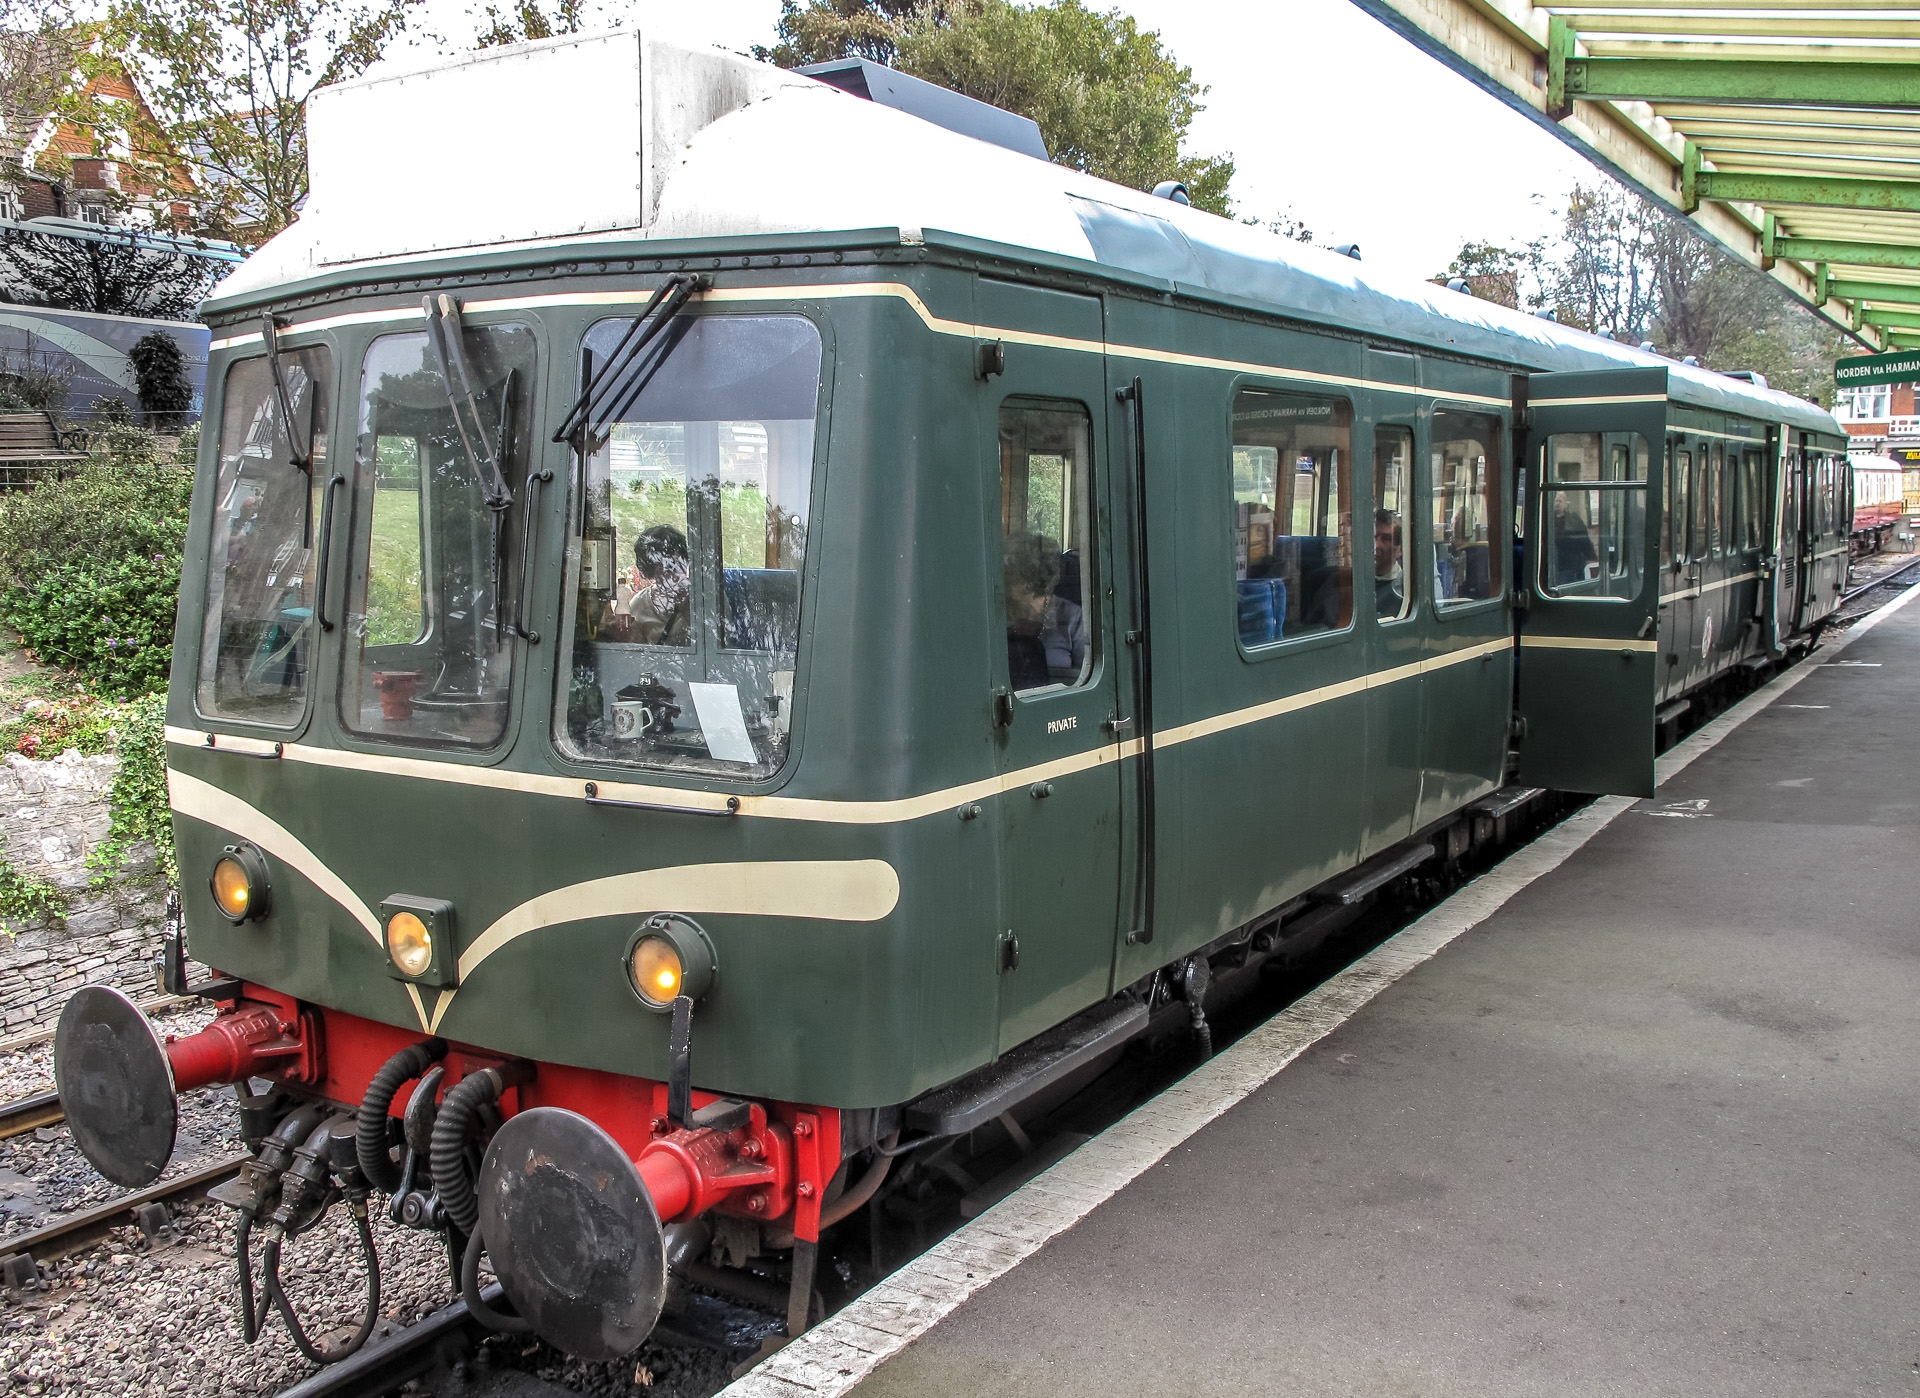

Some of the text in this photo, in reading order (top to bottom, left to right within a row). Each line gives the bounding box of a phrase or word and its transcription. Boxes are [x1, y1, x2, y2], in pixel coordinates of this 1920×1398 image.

[1836, 365, 1871, 379] NORDEN
[1873, 366, 1884, 375] VIA
[1047, 716, 1077, 734] PRIVATE
